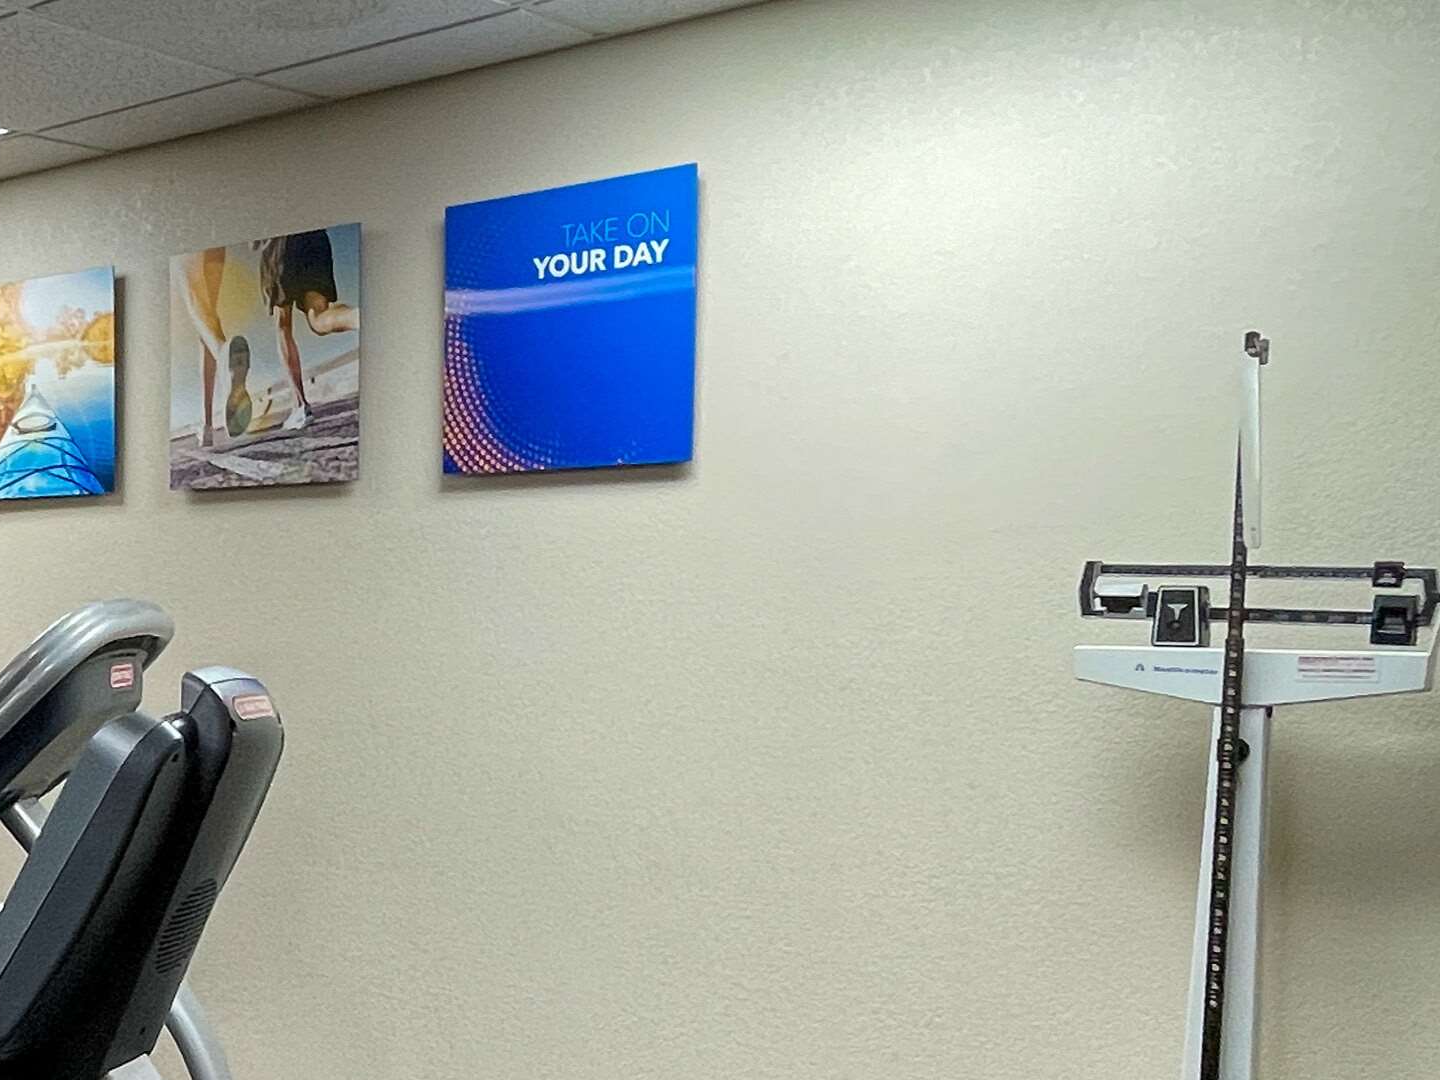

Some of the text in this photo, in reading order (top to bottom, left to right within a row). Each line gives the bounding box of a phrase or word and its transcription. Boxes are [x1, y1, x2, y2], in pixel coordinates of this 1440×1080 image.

[562, 209, 670, 248] TAKE ON
[533, 239, 670, 279] YOUR DAY
